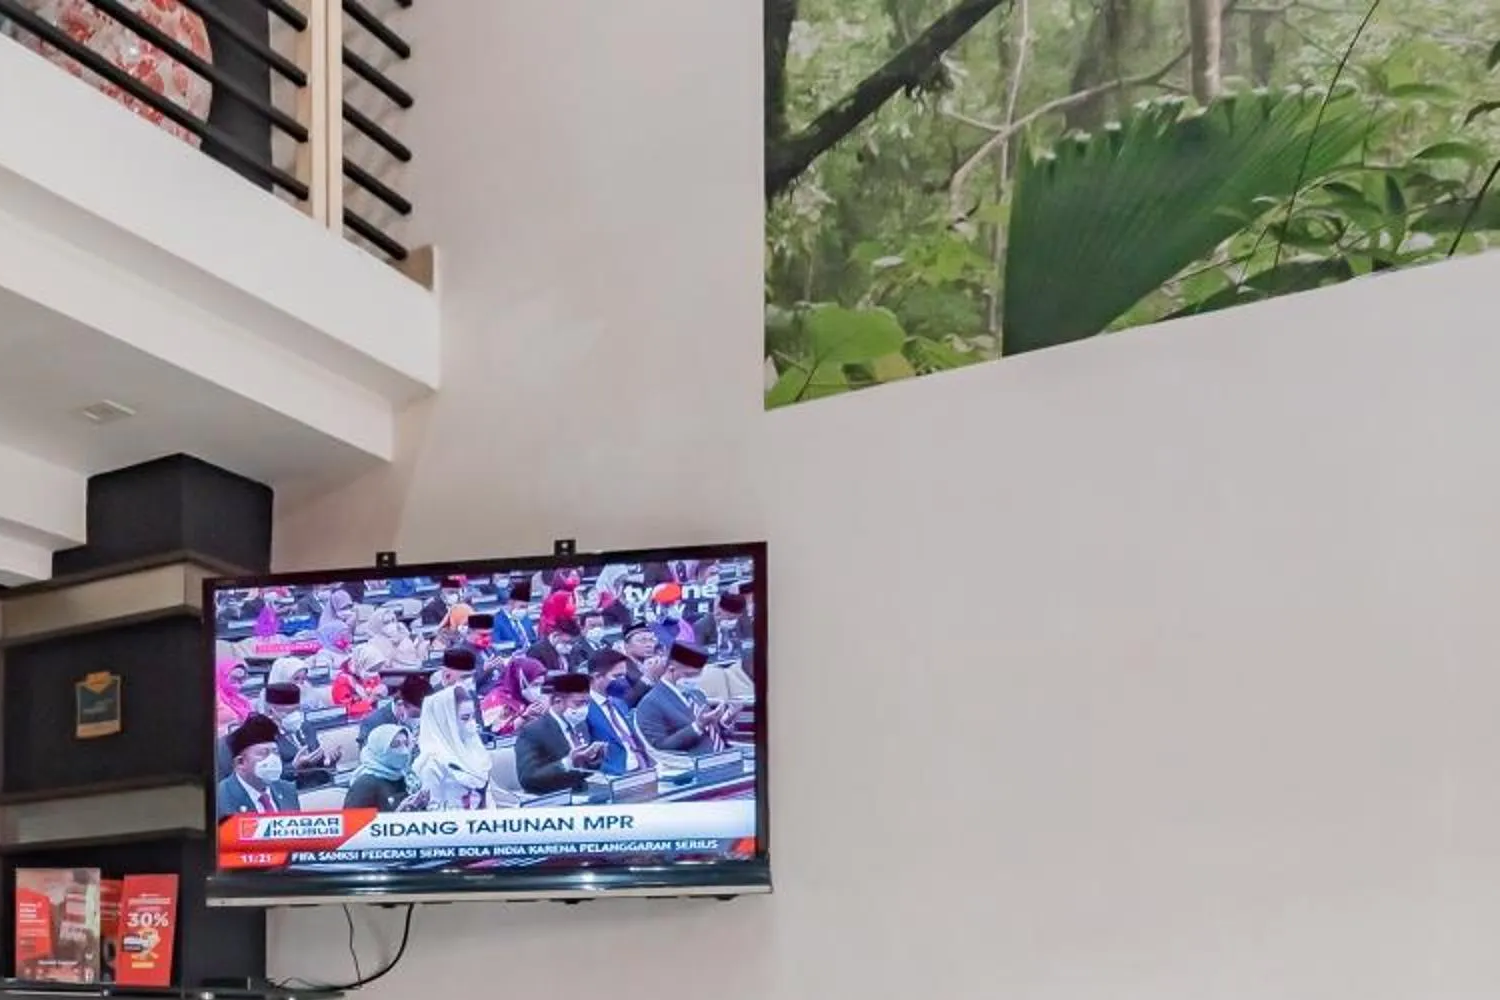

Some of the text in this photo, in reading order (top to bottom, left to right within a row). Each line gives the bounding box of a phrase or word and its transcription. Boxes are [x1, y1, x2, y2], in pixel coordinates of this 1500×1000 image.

[273, 817, 339, 828] KABAR
[370, 815, 634, 838] SIDANG TAHUNAN MPR
[273, 827, 339, 837] KHUSUS
[361, 849, 417, 859] FEDERASI
[420, 847, 455, 858] SEPAK
[458, 847, 491, 857] BOLA
[494, 845, 526, 855] INDIA
[528, 844, 577, 854] KARENA
[579, 841, 671, 853] PELANGGARAN
[675, 839, 718, 850] SERIUS
[127, 911, 169, 928] 30%
